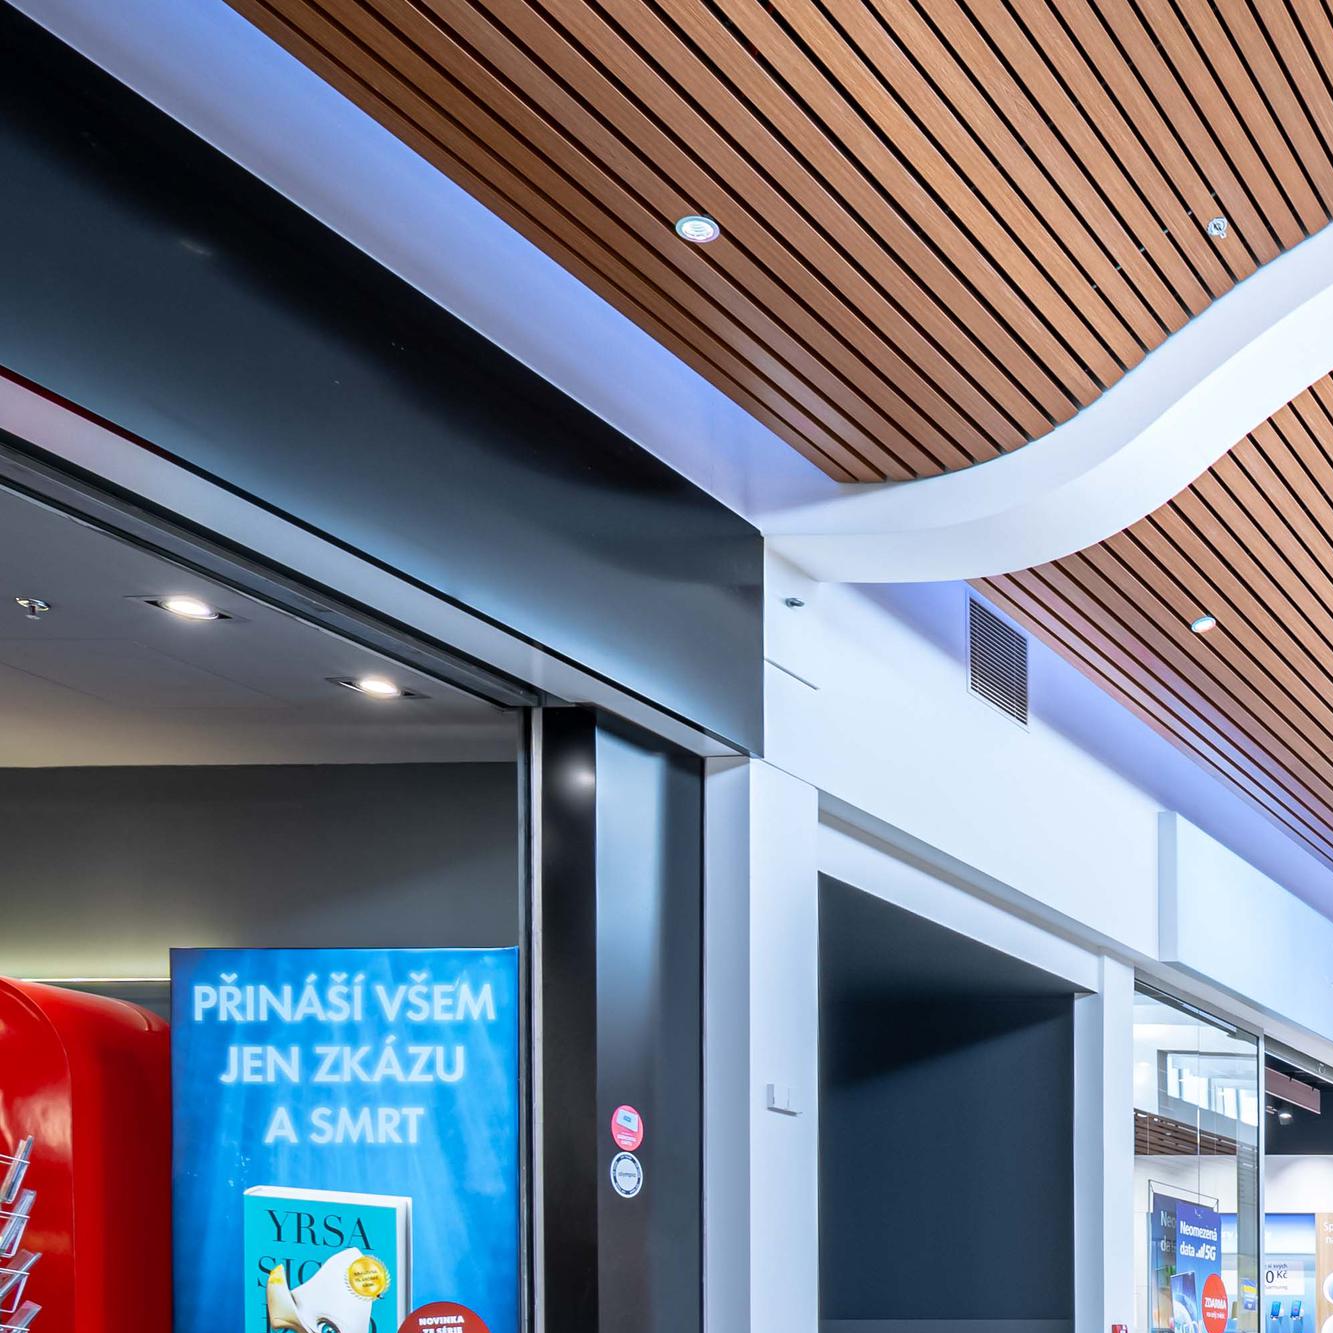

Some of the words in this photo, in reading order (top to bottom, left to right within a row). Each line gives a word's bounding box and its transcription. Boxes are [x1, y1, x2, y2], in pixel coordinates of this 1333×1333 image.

[193, 971, 366, 1022] PŘINÁŠÍ
[375, 971, 497, 1022] VŠEM
[219, 1046, 300, 1084] JEN
[313, 1034, 466, 1083] ZKÁZU
[263, 1106, 299, 1144] A
[310, 1106, 425, 1144] SMRT
[264, 1209, 374, 1250] YRSA
[1179, 1220, 1218, 1242] Neomezená
[1180, 1241, 1196, 1257] data
[1204, 1245, 1217, 1262] 5G
[1204, 1297, 1227, 1309] ZDARMA
[418, 1315, 465, 1326] NOVINKA
